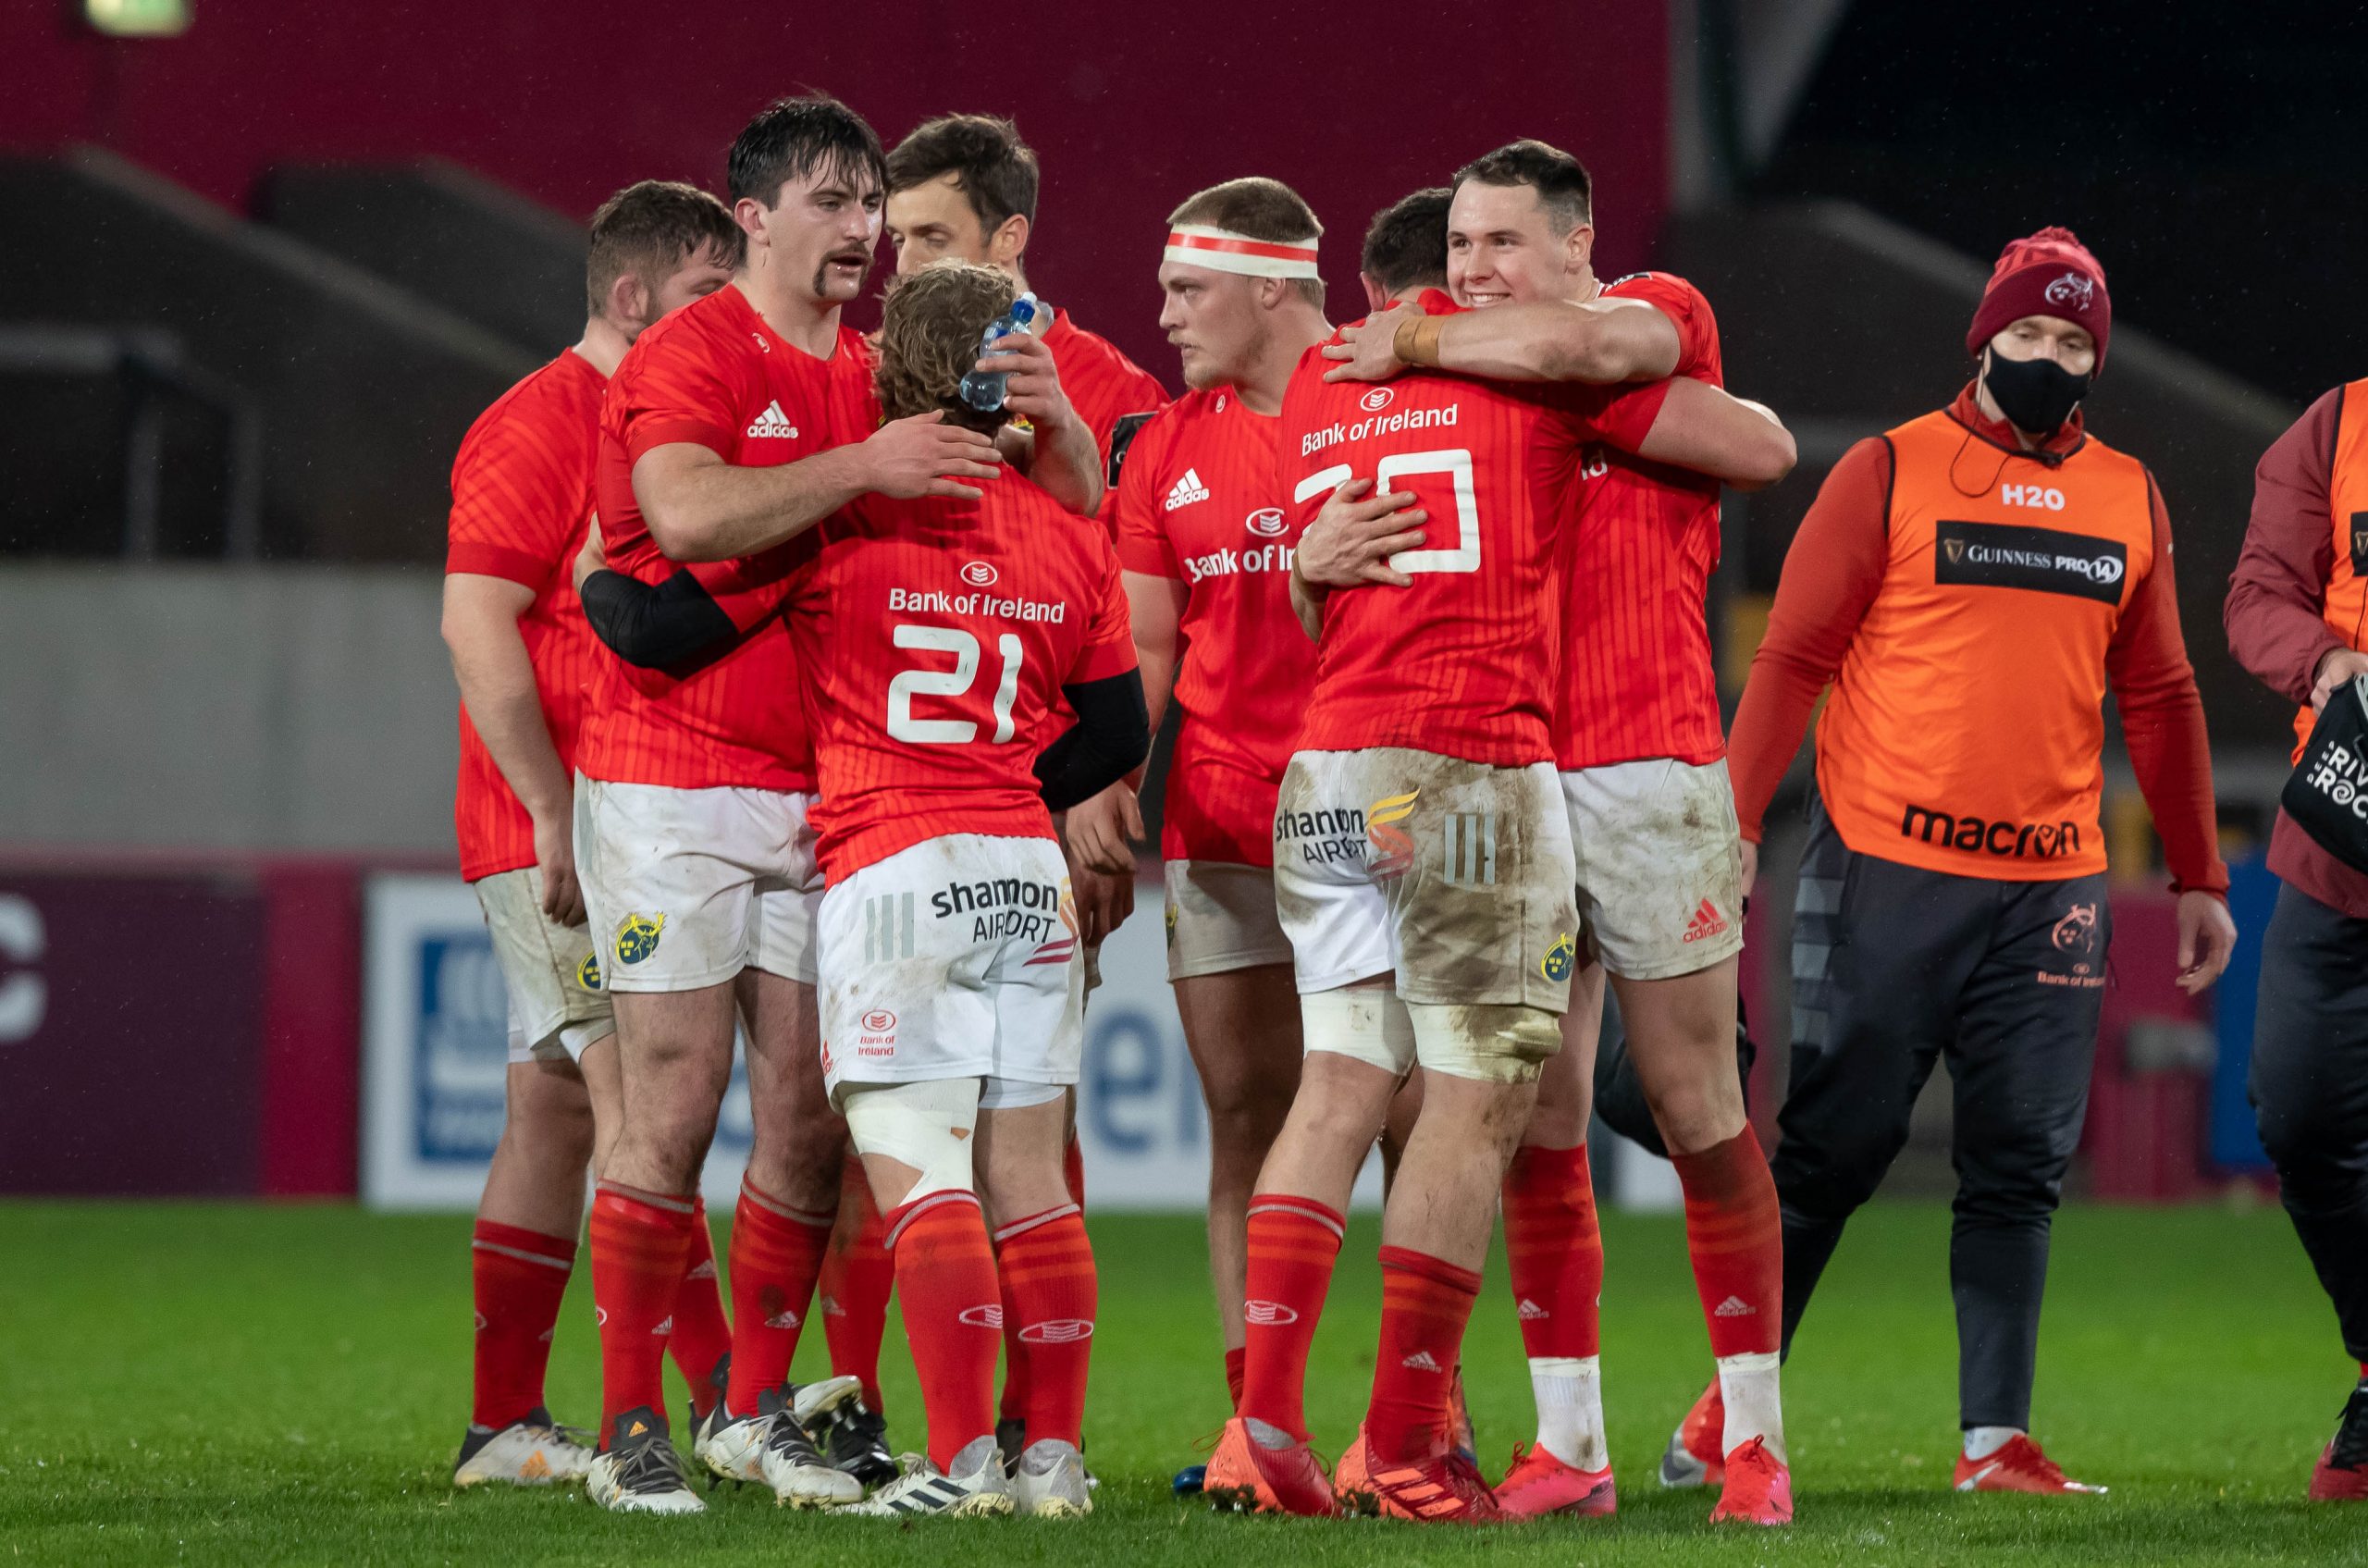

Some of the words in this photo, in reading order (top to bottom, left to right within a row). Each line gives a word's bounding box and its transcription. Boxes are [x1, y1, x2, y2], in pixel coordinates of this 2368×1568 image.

[746, 422, 799, 439] adidas
[1301, 423, 1346, 457] Bank
[1350, 417, 1375, 441] of
[1375, 403, 1458, 437] Ireland
[1166, 488, 1210, 512] adidas
[1242, 544, 1276, 573] of
[1967, 544, 2051, 569] GUINNESS
[889, 587, 953, 613] Bank
[954, 593, 981, 615] of
[982, 594, 1066, 623] Ireland
[887, 623, 1023, 744] 21
[1901, 804, 2080, 858] macron
[972, 909, 1056, 945] AIRORT
[1683, 920, 1728, 944] adidas
[857, 1046, 894, 1056] Ireland
